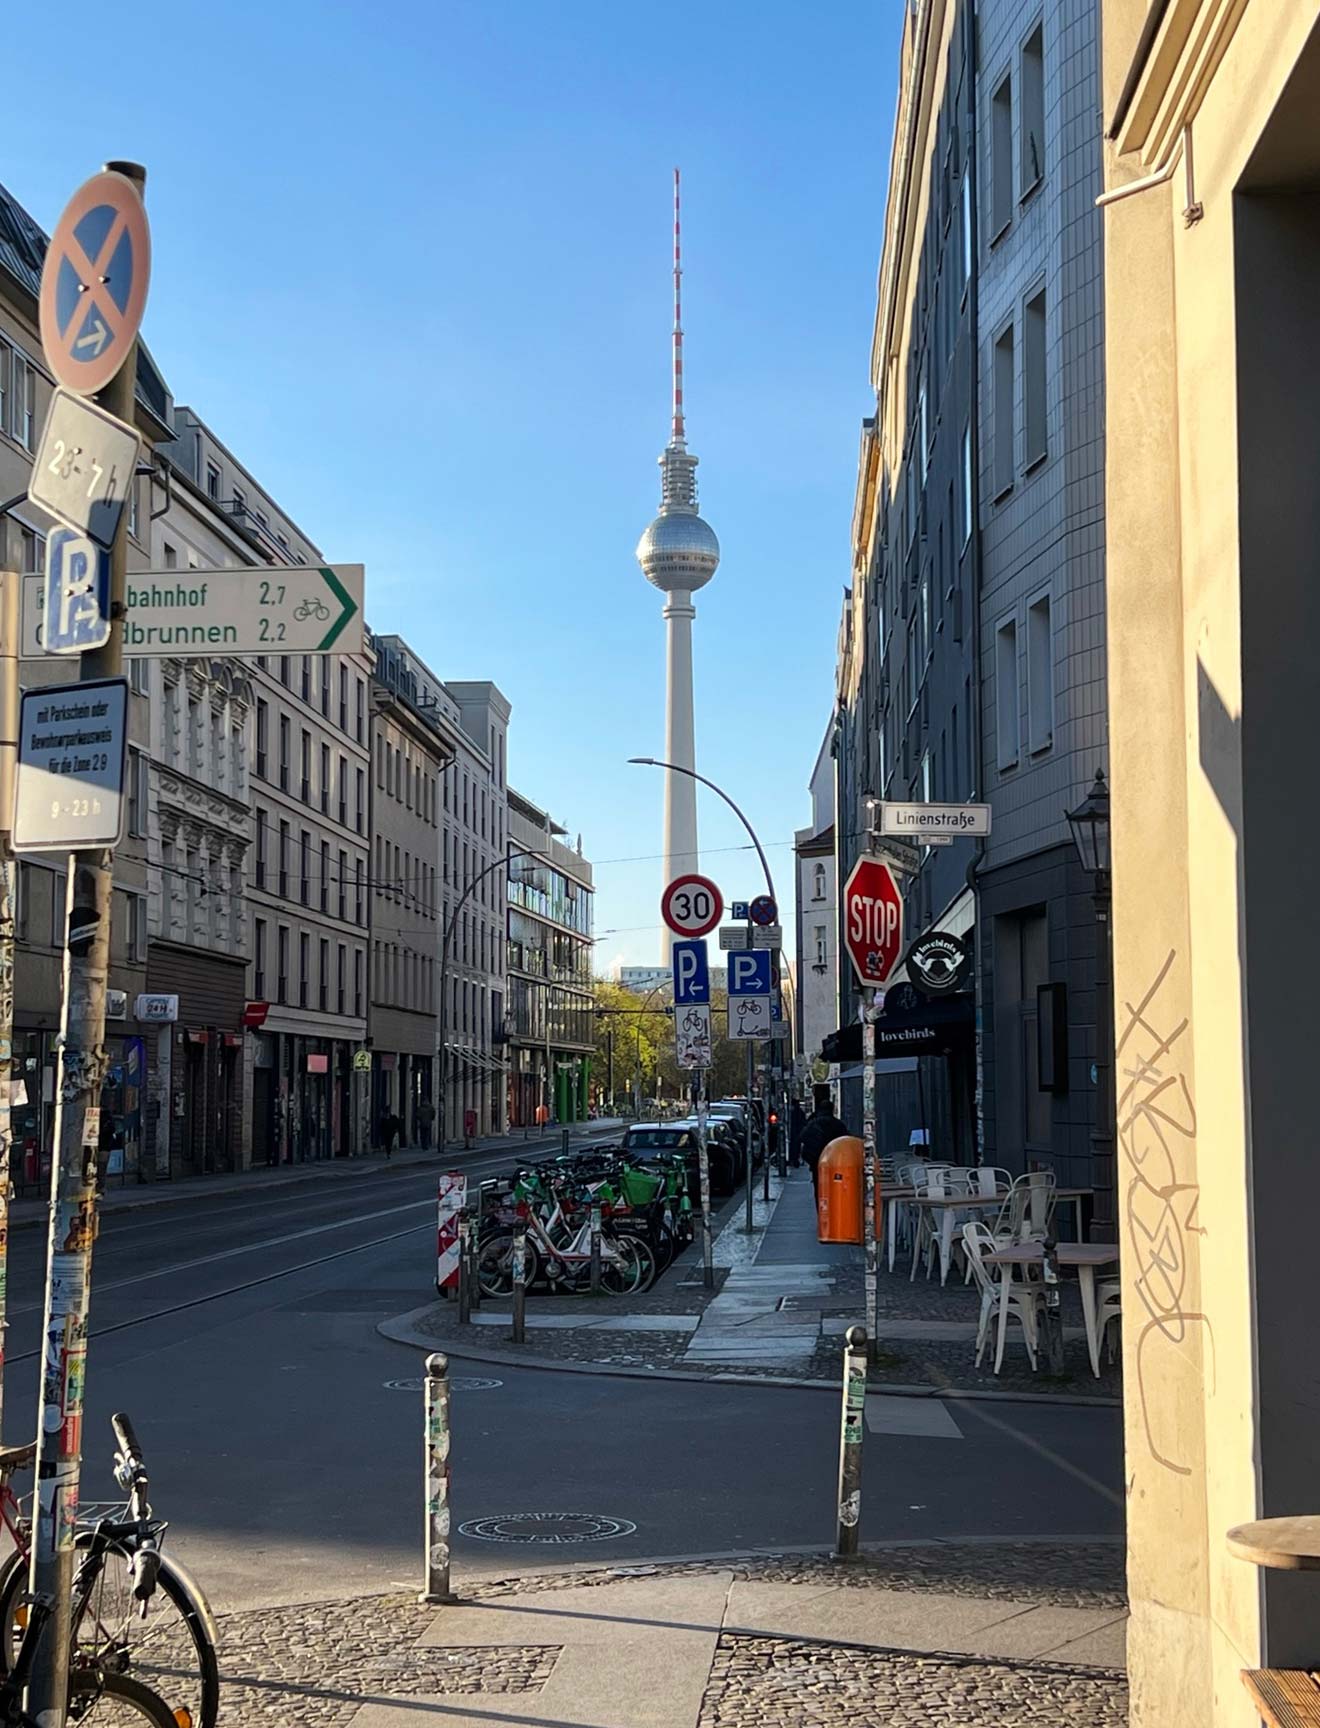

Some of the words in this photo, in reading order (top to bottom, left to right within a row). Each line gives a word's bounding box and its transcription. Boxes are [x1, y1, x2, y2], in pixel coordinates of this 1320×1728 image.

[103, 464, 117, 509] h
[58, 538, 97, 635] P
[259, 581, 286, 606] 2,7
[259, 617, 286, 643] 2,2
[37, 706, 49, 724] mit
[51, 702, 90, 723] Parkschein
[91, 700, 109, 717] oder
[31, 726, 113, 750] Bewohnerparkausweis
[74, 756, 91, 773] Zone
[92, 753, 108, 772] 29
[896, 810, 975, 829] Linienstraße
[674, 892, 710, 921] 30
[733, 903, 745, 919] P
[850, 894, 898, 949] STOP
[678, 949, 698, 997] P
[734, 956, 758, 990] P
[880, 1027, 937, 1043] lovebirds
